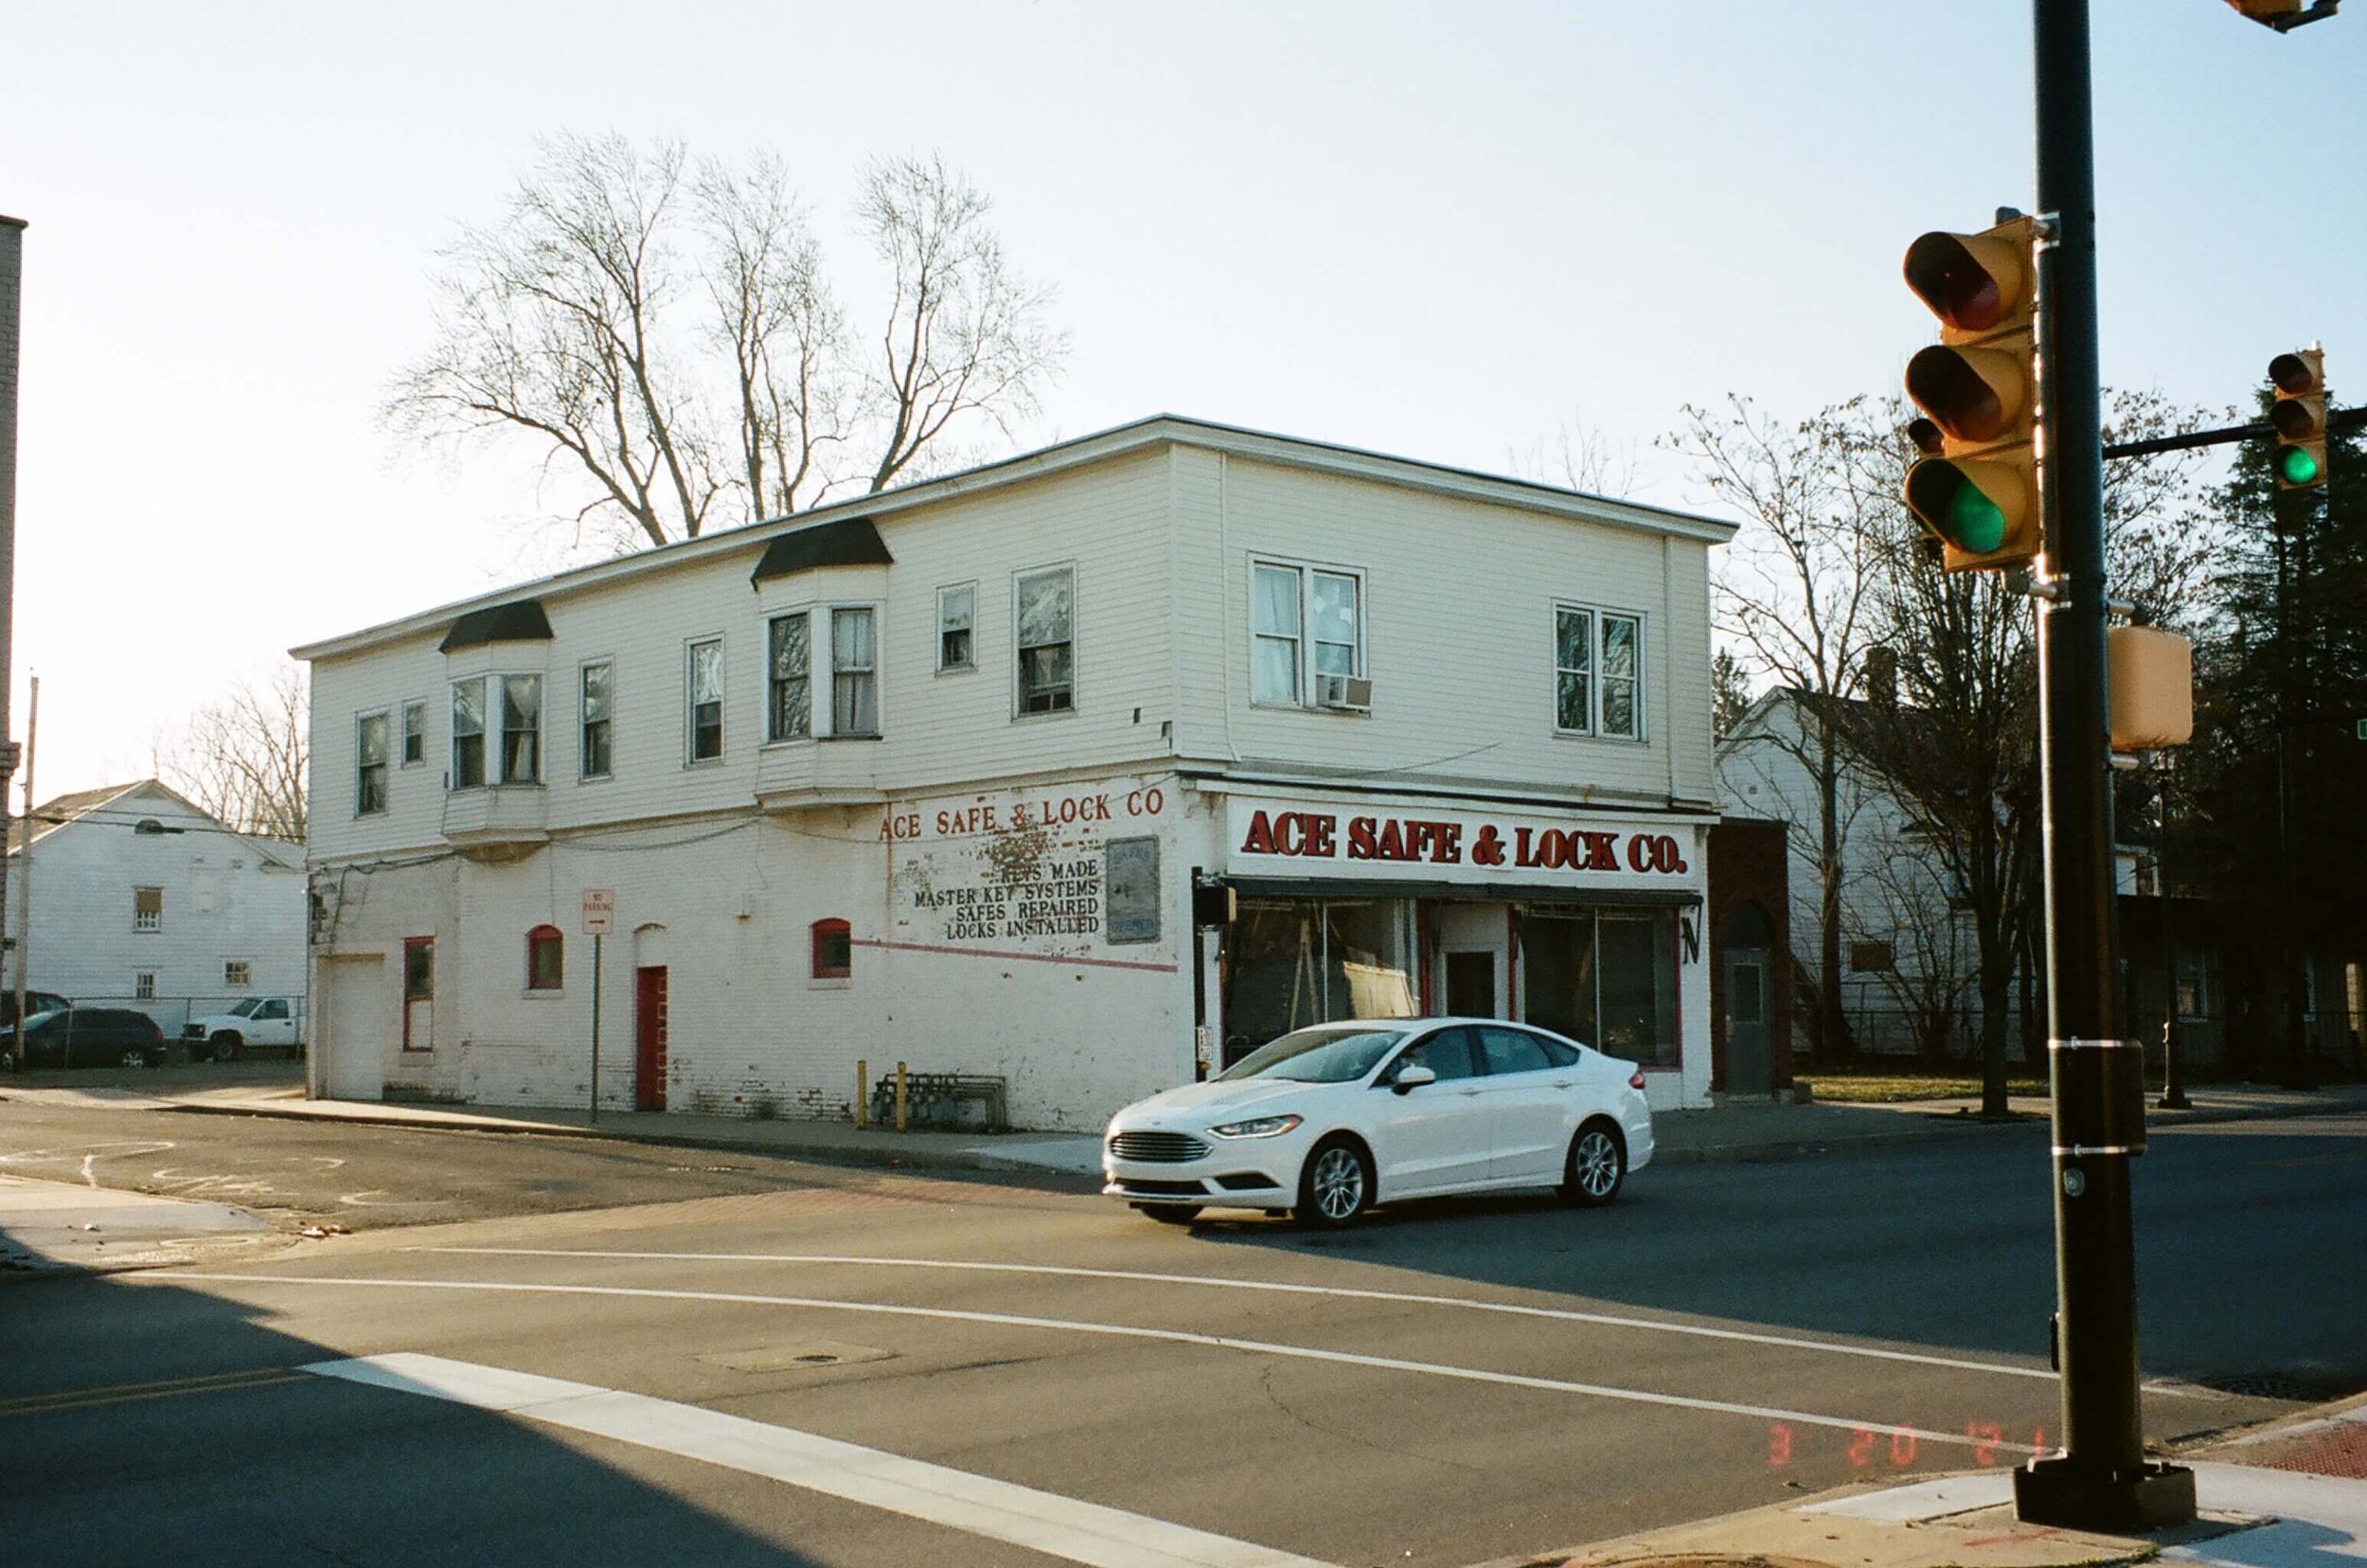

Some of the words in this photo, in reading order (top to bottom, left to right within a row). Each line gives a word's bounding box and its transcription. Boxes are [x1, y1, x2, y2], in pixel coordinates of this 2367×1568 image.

[879, 814, 921, 841] ACE
[936, 807, 996, 834] SAFE
[1013, 803, 1025, 827] &
[1043, 793, 1112, 827] LOCK
[1127, 788, 1164, 816] CO
[1241, 810, 1336, 857] ACE
[1347, 817, 1462, 864] SAFE
[1472, 825, 1505, 865] &
[1515, 827, 1620, 871] LOCK
[1628, 833, 1688, 874] CO.
[1001, 864, 1041, 884] KEYS
[1050, 859, 1097, 880] MADE
[915, 888, 975, 907] MASTER
[983, 885, 1013, 902] KEY
[1024, 879, 1098, 899] SYSTEMS
[956, 903, 1006, 922] SAFES
[1019, 898, 1098, 918] REPAIRED
[947, 921, 996, 939] LOCKS
[1006, 916, 1099, 936] INSTALLED
